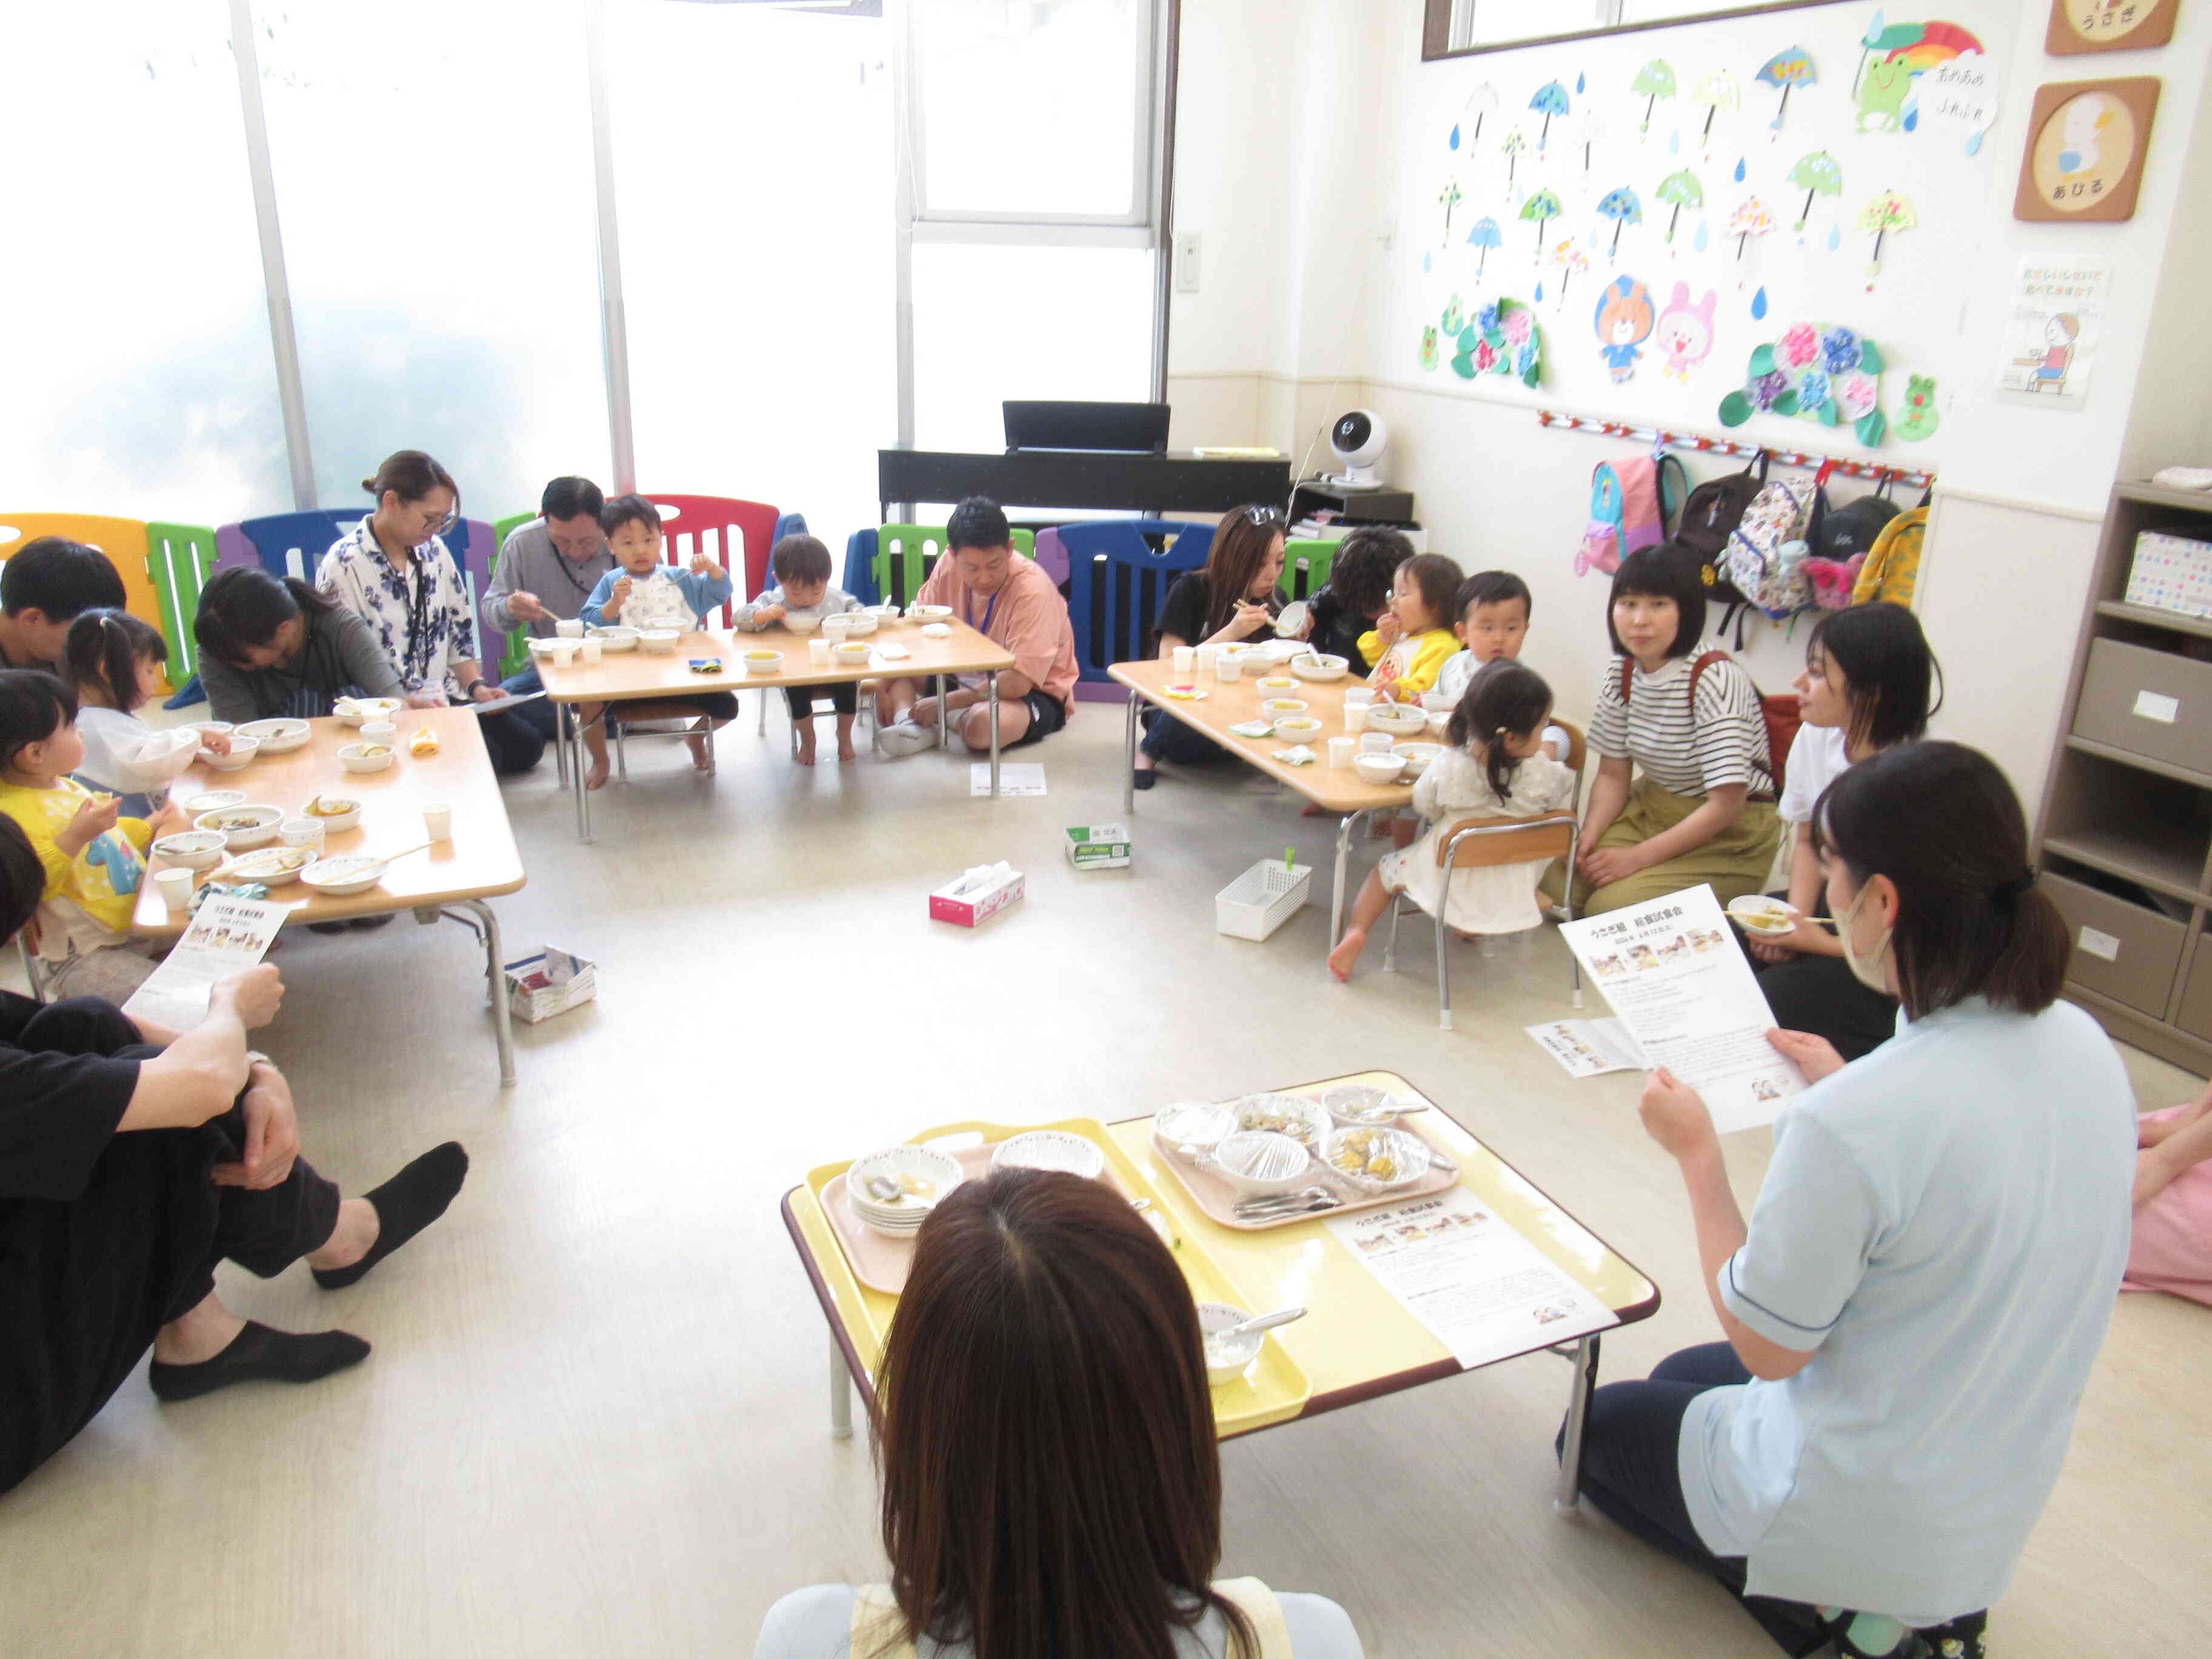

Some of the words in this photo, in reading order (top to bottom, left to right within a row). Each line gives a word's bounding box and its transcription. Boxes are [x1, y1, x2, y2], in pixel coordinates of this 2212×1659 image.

[2082, 5, 2135, 30] うさぎ
[1936, 65, 1985, 86] あめあめ
[1936, 97, 1984, 121] ふれふれ
[2053, 178, 2103, 200] あひる
